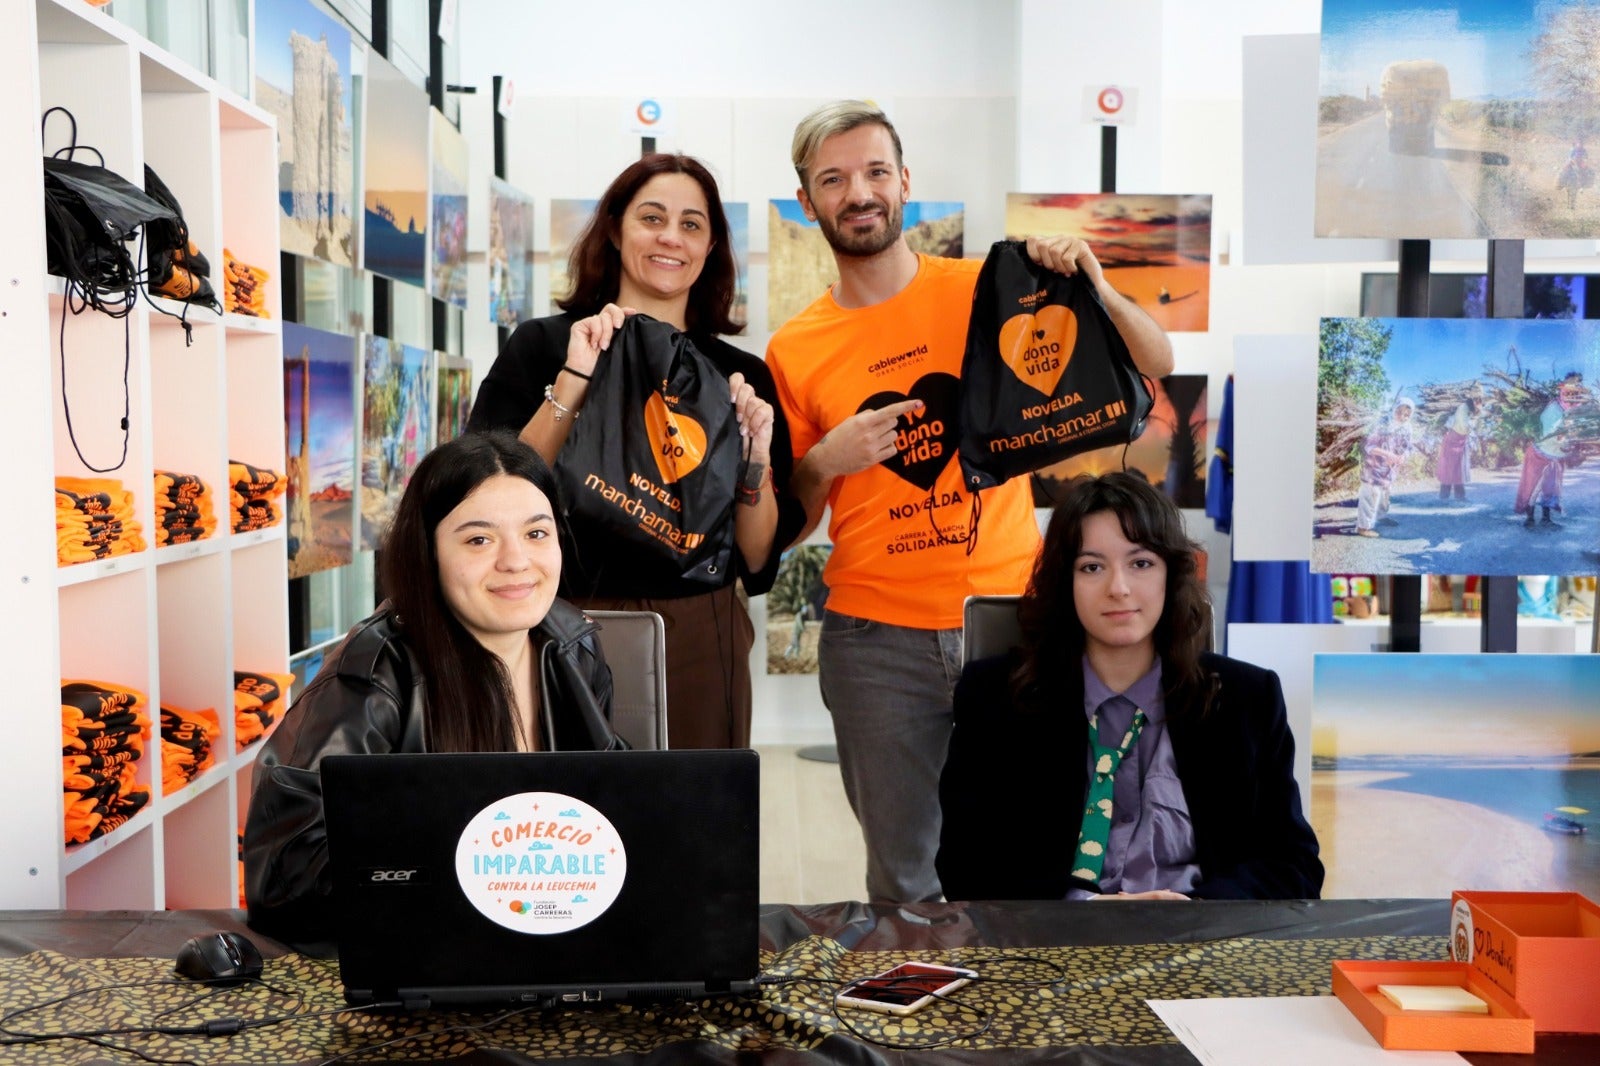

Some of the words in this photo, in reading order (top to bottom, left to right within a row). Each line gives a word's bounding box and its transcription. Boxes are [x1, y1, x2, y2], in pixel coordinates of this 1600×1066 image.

[1023, 342, 1060, 361] dono
[1026, 357, 1060, 376] vida
[1022, 392, 1083, 420] NOVELDA
[896, 420, 944, 451] dono
[990, 409, 1102, 453] manchamar
[903, 439, 943, 466] vida
[629, 472, 681, 512] NOVELD
[889, 490, 963, 520] NOVELDA
[585, 473, 686, 544] manchamar
[887, 532, 966, 555] SOLIDARIAS
[895, 530, 927, 541] CARRERA
[491, 821, 593, 848] COMERCIO
[371, 870, 417, 881] acer
[474, 853, 606, 875] IMPARABLE
[487, 881, 527, 891] CONTRA
[531, 881, 543, 891] LA
[546, 881, 597, 891] LEUCEMIA
